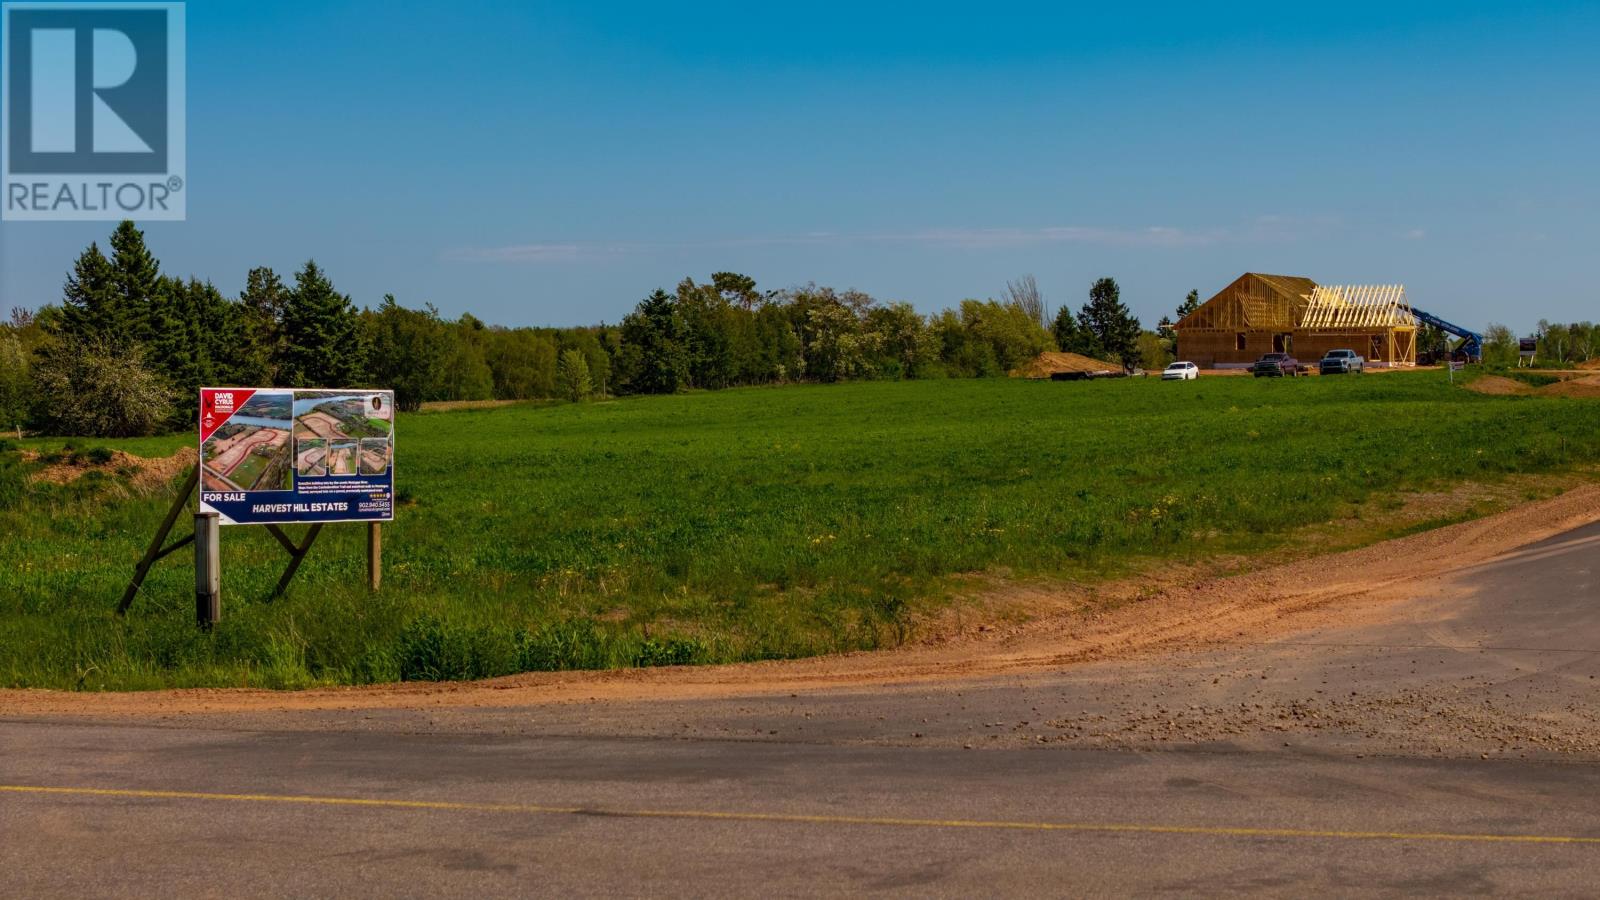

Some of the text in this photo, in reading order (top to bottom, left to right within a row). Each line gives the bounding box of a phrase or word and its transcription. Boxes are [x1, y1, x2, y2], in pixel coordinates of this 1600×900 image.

[203, 493, 246, 502] FOR SALE
[252, 502, 348, 513] HARVEST HILL ESTATES
